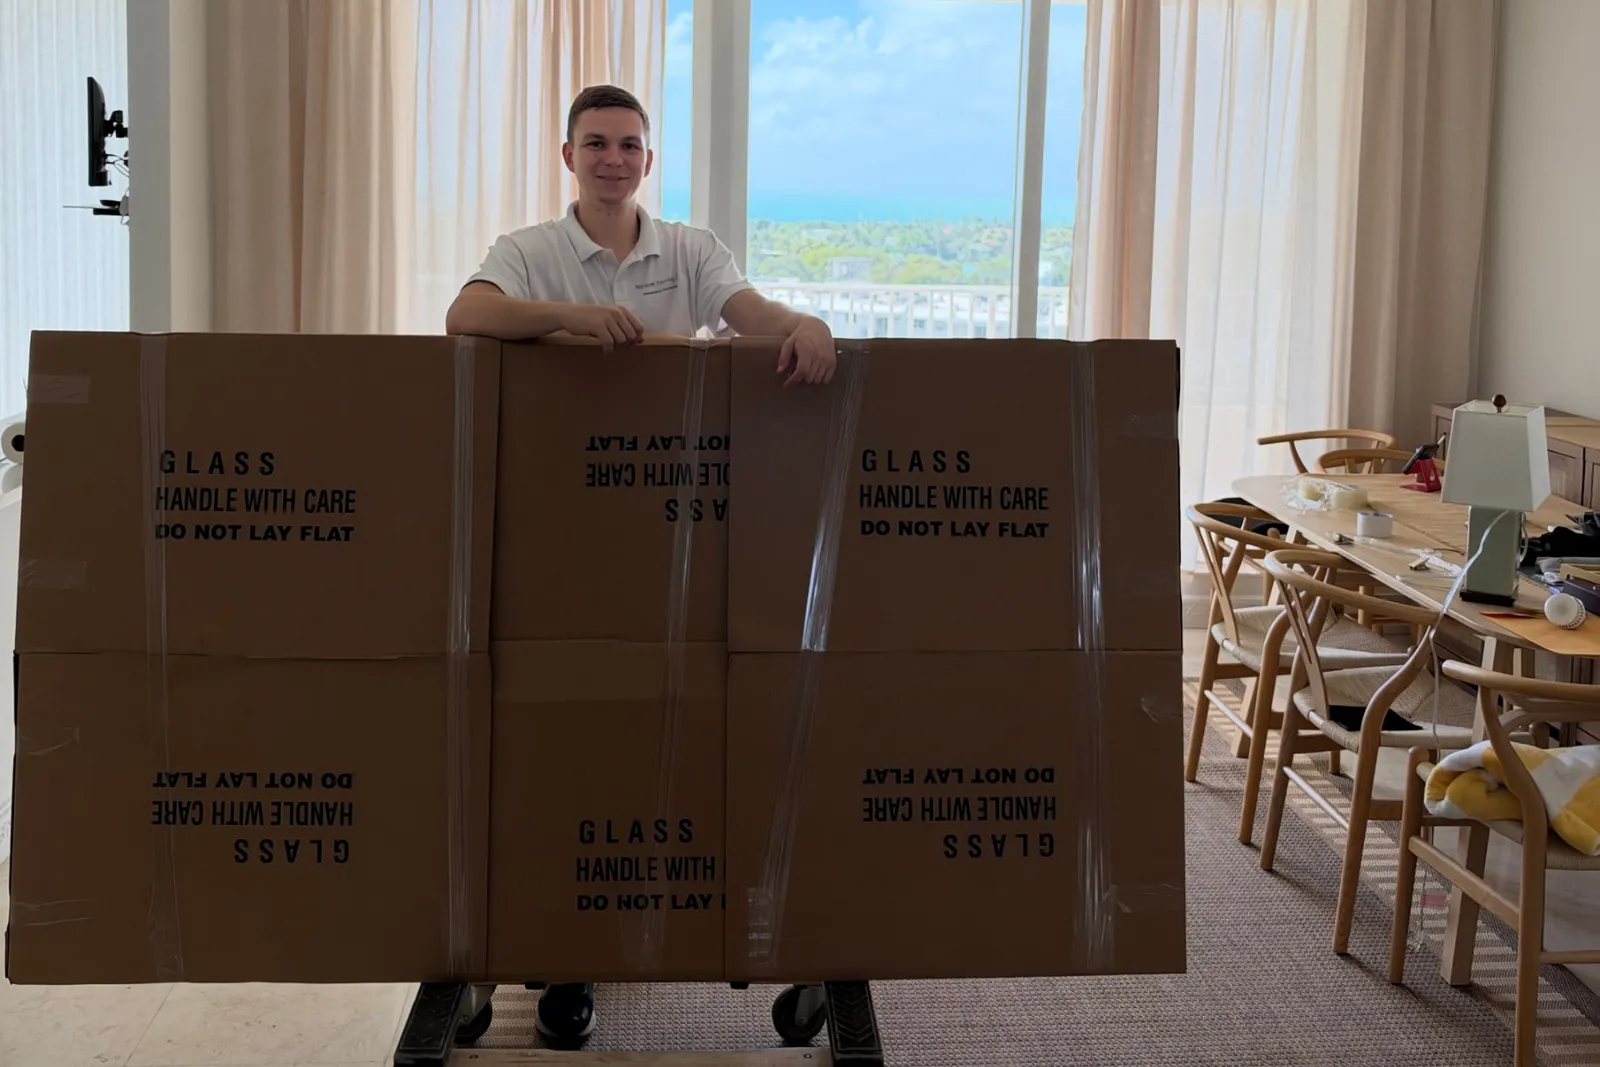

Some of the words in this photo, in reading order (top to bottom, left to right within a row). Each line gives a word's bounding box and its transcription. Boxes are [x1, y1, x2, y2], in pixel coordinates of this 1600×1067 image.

[585, 436, 638, 451] FLAT
[647, 436, 686, 451] LAY
[161, 450, 276, 476] GLASS
[862, 449, 971, 474] GLASS
[586, 463, 636, 487] CARE
[645, 463, 693, 486] WITH
[699, 463, 731, 486] DLE
[155, 486, 238, 512] HANDLE
[244, 488, 296, 513] WITH
[304, 489, 356, 514] CARE
[859, 484, 937, 509] HANDLE
[942, 485, 992, 510] WITH
[1000, 486, 1049, 511] CARE
[665, 498, 729, 522] ASS
[155, 523, 187, 540] DO
[194, 524, 242, 541] NOT
[249, 525, 292, 541] LAY
[300, 525, 355, 542] FLAT
[860, 520, 891, 536] DO
[898, 520, 944, 536] NOT
[950, 520, 990, 538] LAY
[998, 522, 1049, 538] FLAT
[152, 772, 207, 788] FLAT
[215, 772, 258, 788] LAY
[264, 772, 313, 789] NOT
[320, 772, 353, 789] DO
[862, 768, 915, 785] FLAT
[923, 768, 964, 784] LAY
[970, 768, 1016, 784] NOT
[1024, 767, 1055, 784] DO
[151, 800, 204, 826] CARE
[212, 801, 264, 826] WITH
[270, 801, 353, 827] HANDLE
[862, 797, 913, 822] CARE
[921, 797, 972, 822] WITH
[977, 796, 1056, 821] HANDLE
[579, 819, 693, 844] GLASS
[234, 838, 349, 864] GLASS
[943, 833, 1054, 859] GLASS
[576, 856, 658, 882] HANDLE
[664, 856, 715, 881] WITH
[577, 894, 609, 911] DO
[617, 894, 664, 910] NOT
[671, 893, 713, 910] LAY
